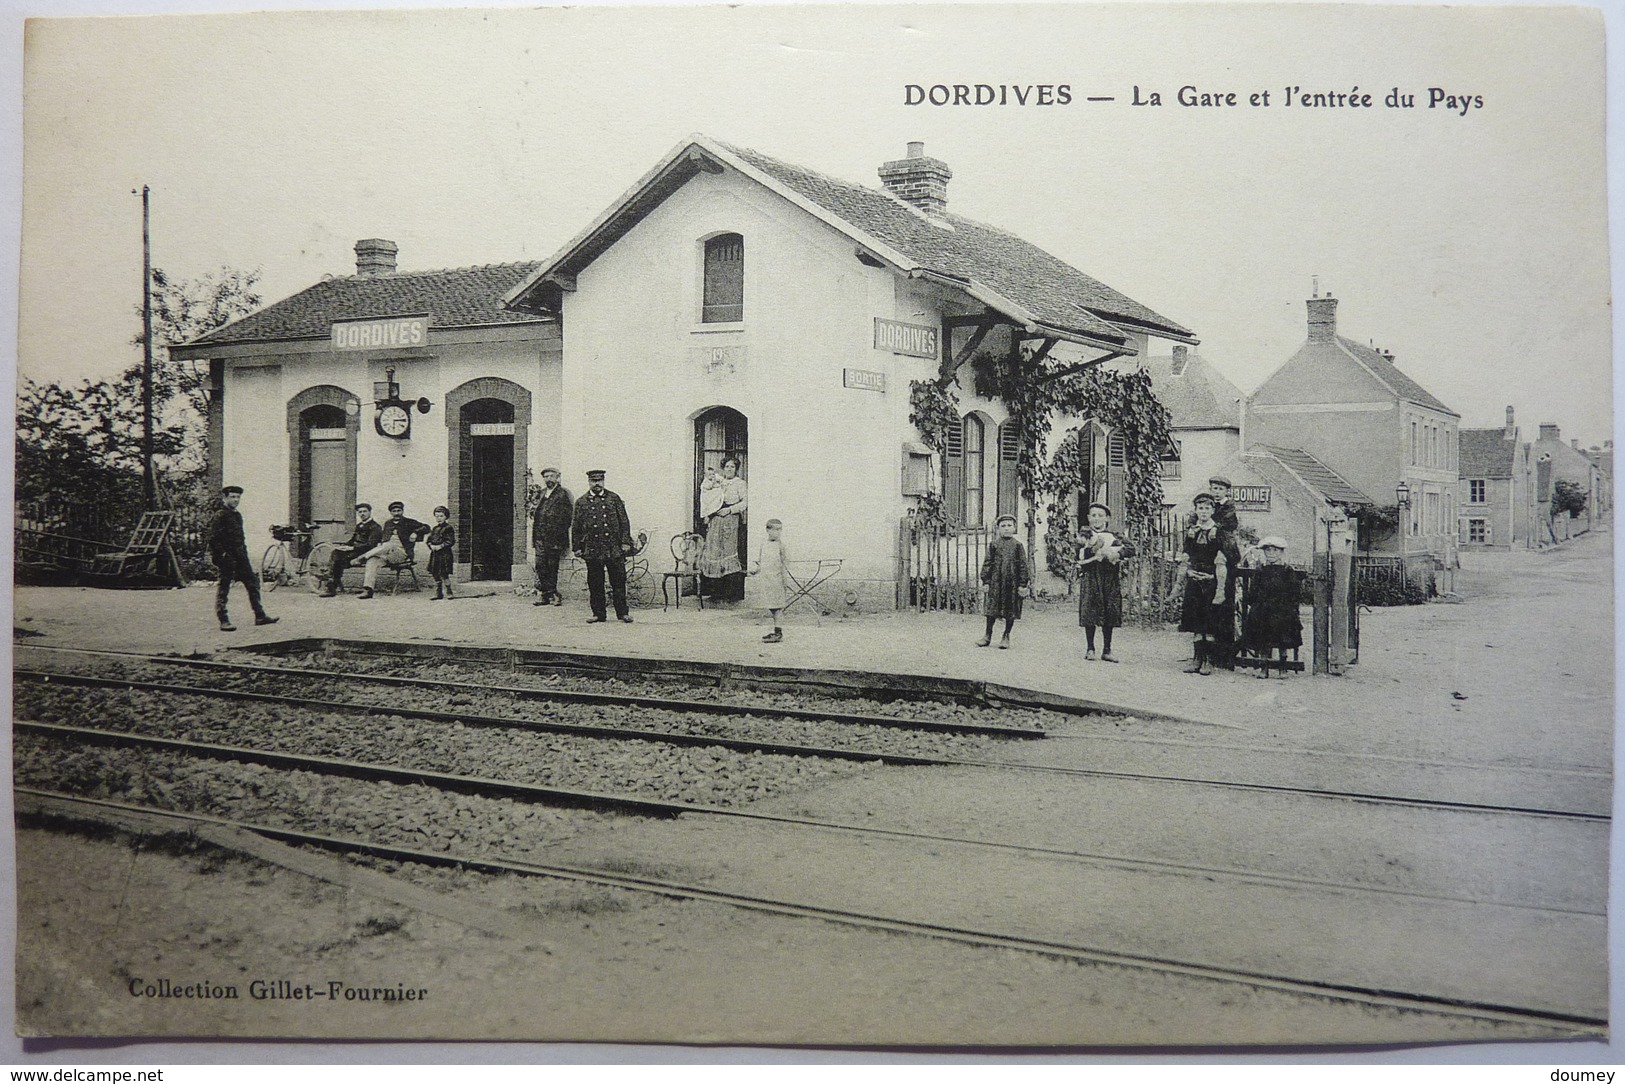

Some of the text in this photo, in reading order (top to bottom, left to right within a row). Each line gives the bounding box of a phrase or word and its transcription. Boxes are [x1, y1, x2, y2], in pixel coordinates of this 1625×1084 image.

[336, 321, 421, 348] DORDIVES
[879, 322, 935, 354] DORDIVES
[849, 371, 882, 386] SORTIE
